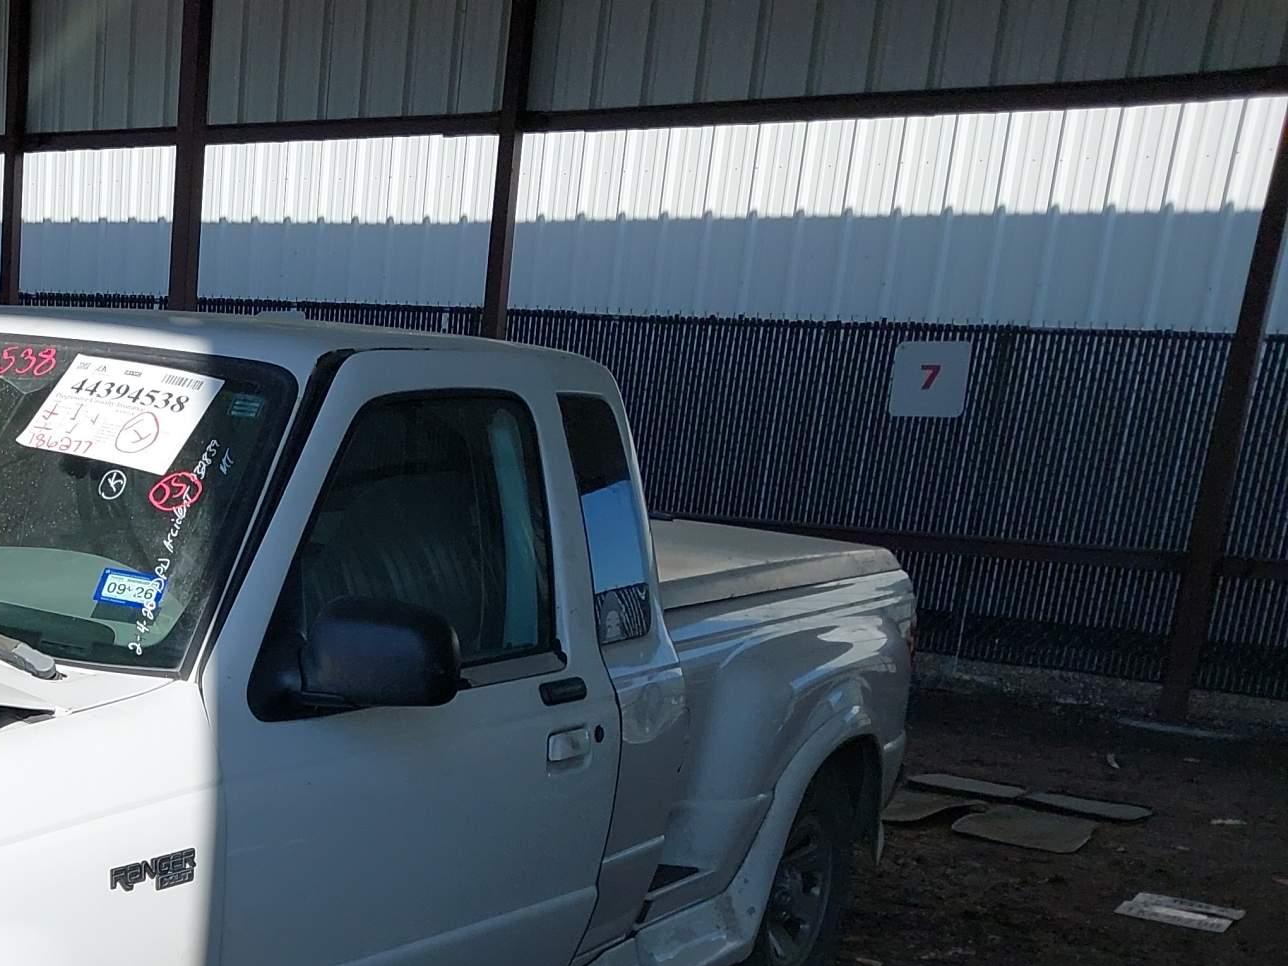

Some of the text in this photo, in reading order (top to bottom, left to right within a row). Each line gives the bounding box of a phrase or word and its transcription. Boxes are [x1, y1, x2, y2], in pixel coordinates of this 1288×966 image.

[920, 364, 942, 390] 7
[70, 378, 190, 414] 44394538
[28, 431, 94, 454] 186277
[107, 582, 155, 600] 09 26
[110, 847, 197, 892] RANGER
